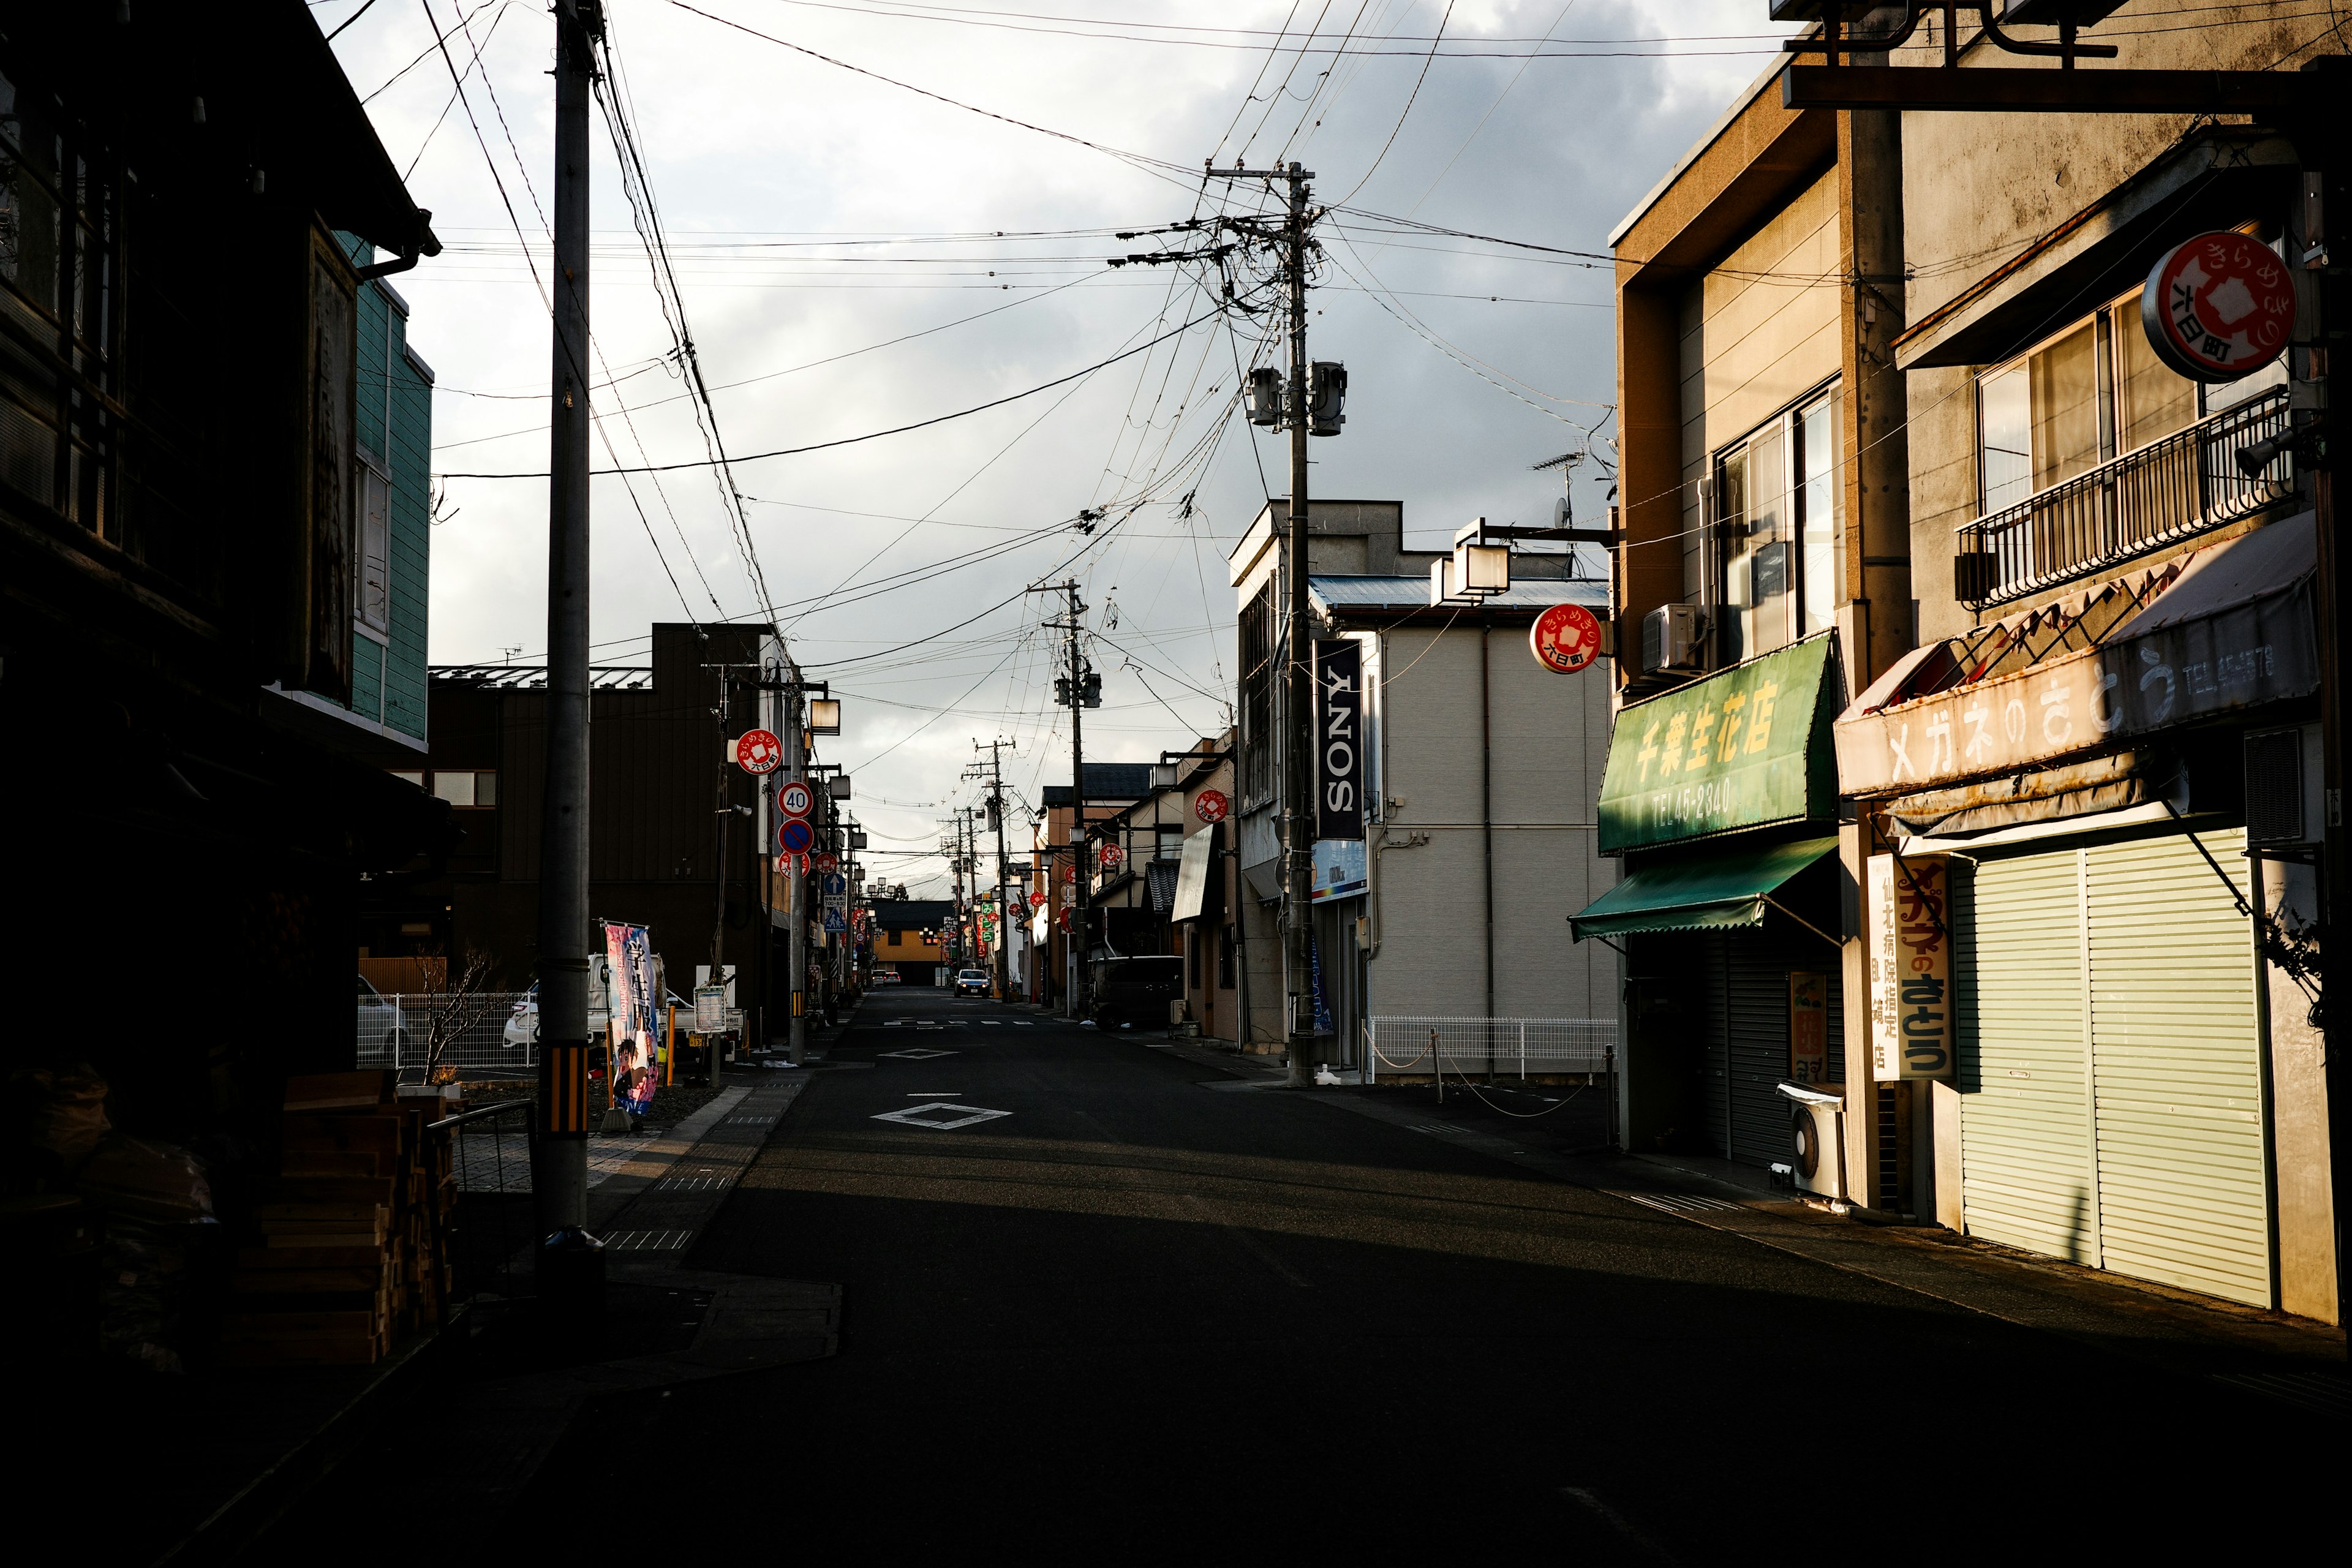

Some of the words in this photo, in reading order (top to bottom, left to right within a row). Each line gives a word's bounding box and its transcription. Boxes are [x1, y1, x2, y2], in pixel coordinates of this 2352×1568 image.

[2171, 283, 2231, 362] 六日町
[2206, 243, 2290, 347] きらめきの
[1544, 609, 1597, 644] きらめきの
[1544, 643, 1584, 666] 六日町
[1326, 665, 1354, 812] SONY
[1637, 679, 1779, 782] 千葉生花店
[1890, 646, 2176, 782] メガネのさとう
[750, 753, 778, 771] 六日町
[786, 792, 805, 808] 40
[1196, 802, 1212, 816] 六日町
[617, 954, 627, 984] School
[1882, 876, 1898, 1039] 仙北病院指定
[1898, 862, 1948, 1071] メガネのさとう
[620, 984, 629, 1022] Uniform
